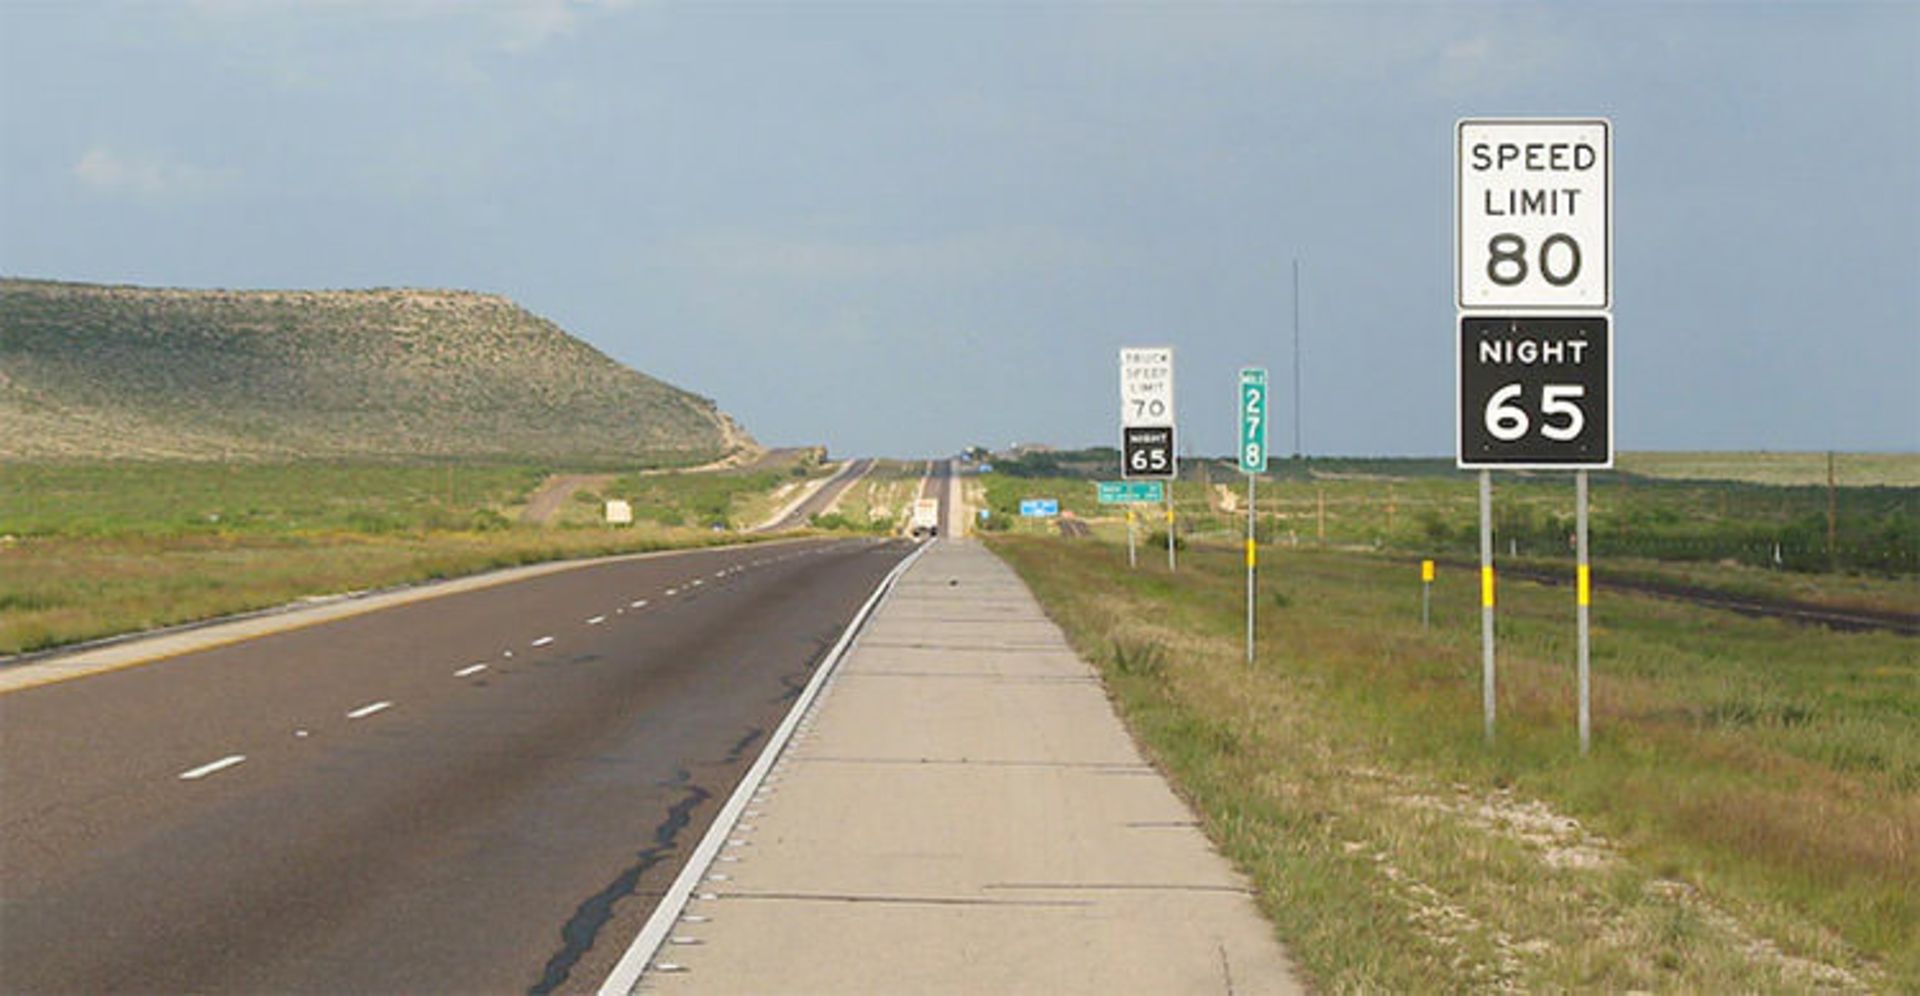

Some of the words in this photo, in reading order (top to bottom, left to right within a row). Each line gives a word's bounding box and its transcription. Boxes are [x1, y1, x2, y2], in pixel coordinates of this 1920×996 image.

[1471, 142, 1597, 172] SPEED
[1484, 188, 1582, 217] LIMIT
[1486, 232, 1582, 288] 80
[1479, 339, 1589, 365] NIGHT
[1131, 398, 1166, 418] 70
[1484, 383, 1587, 442] 65
[1131, 449, 1167, 470] 65
